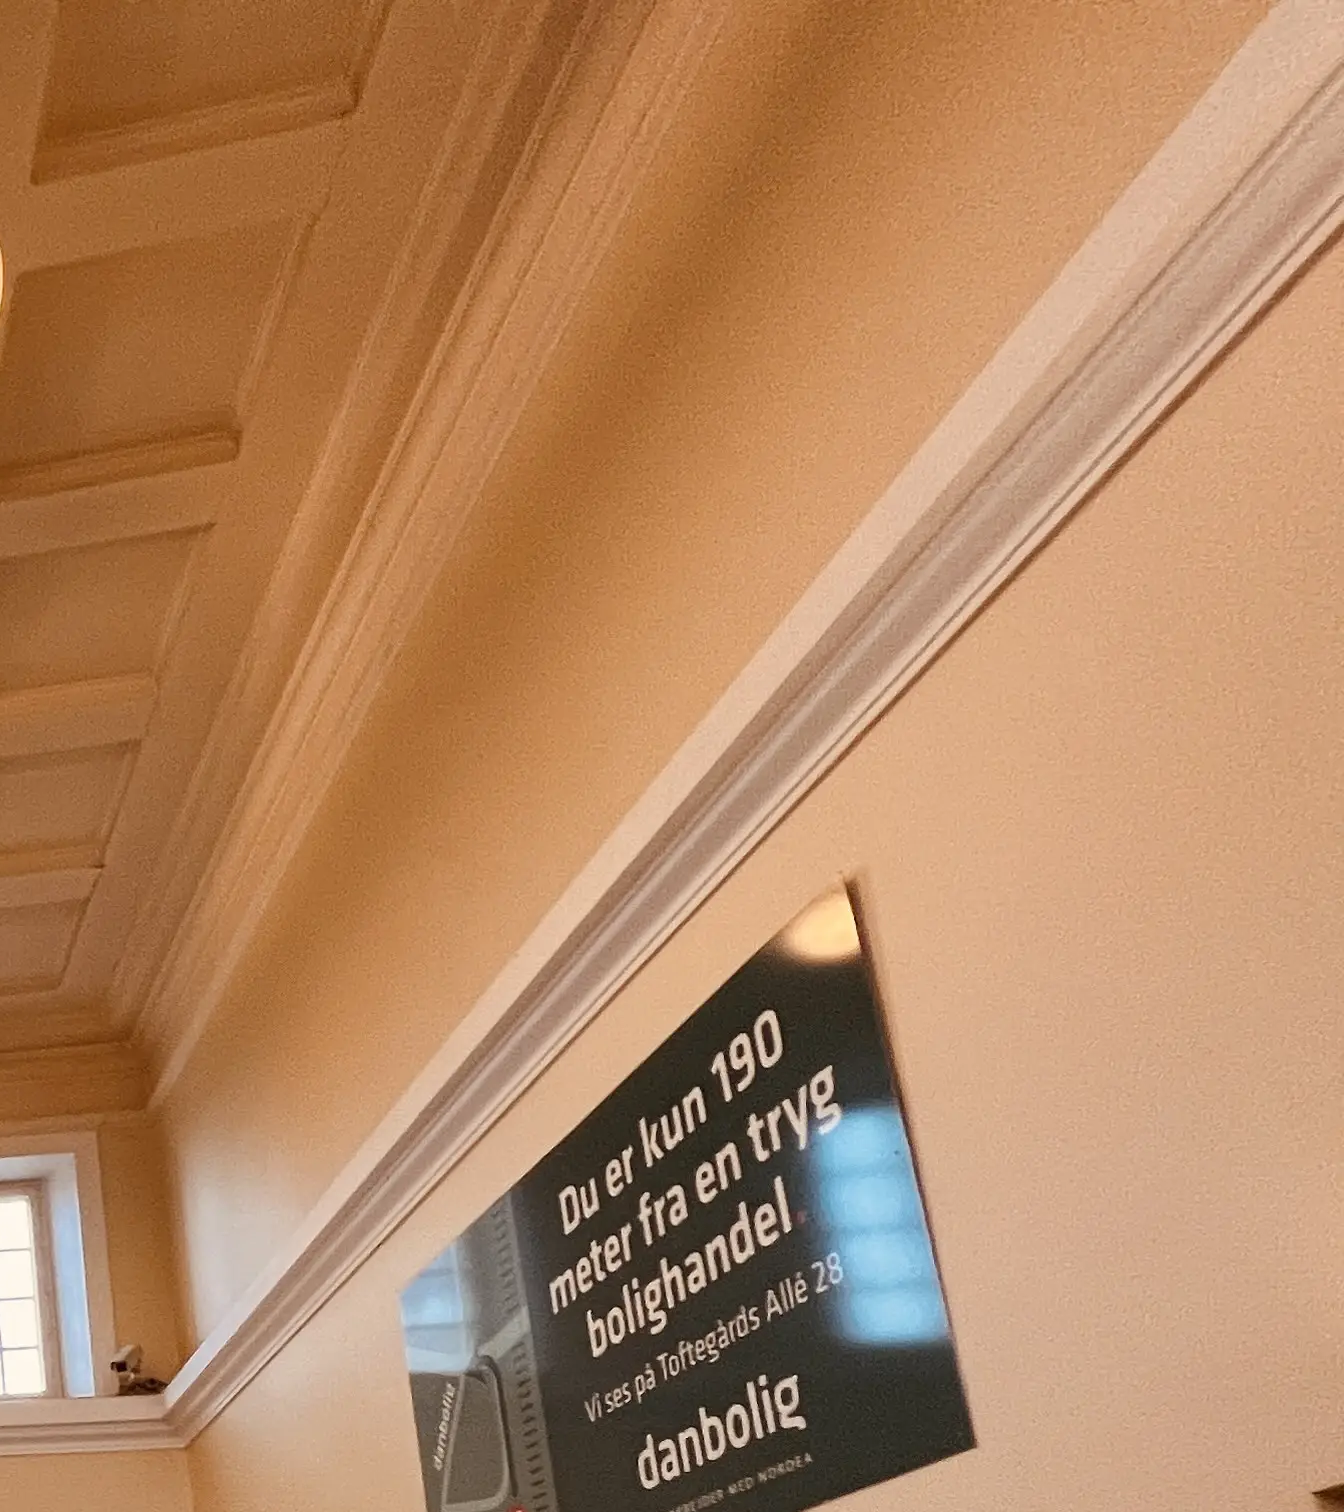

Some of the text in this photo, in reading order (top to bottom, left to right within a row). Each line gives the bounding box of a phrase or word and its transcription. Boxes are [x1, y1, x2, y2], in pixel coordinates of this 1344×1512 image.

[548, 1064, 843, 1315] meter fra en tryg
[558, 1009, 783, 1236] Du er kun 190
[583, 1251, 844, 1422] Vi ses på Toftegårds Allé 28
[637, 1374, 808, 1490] danbolig
